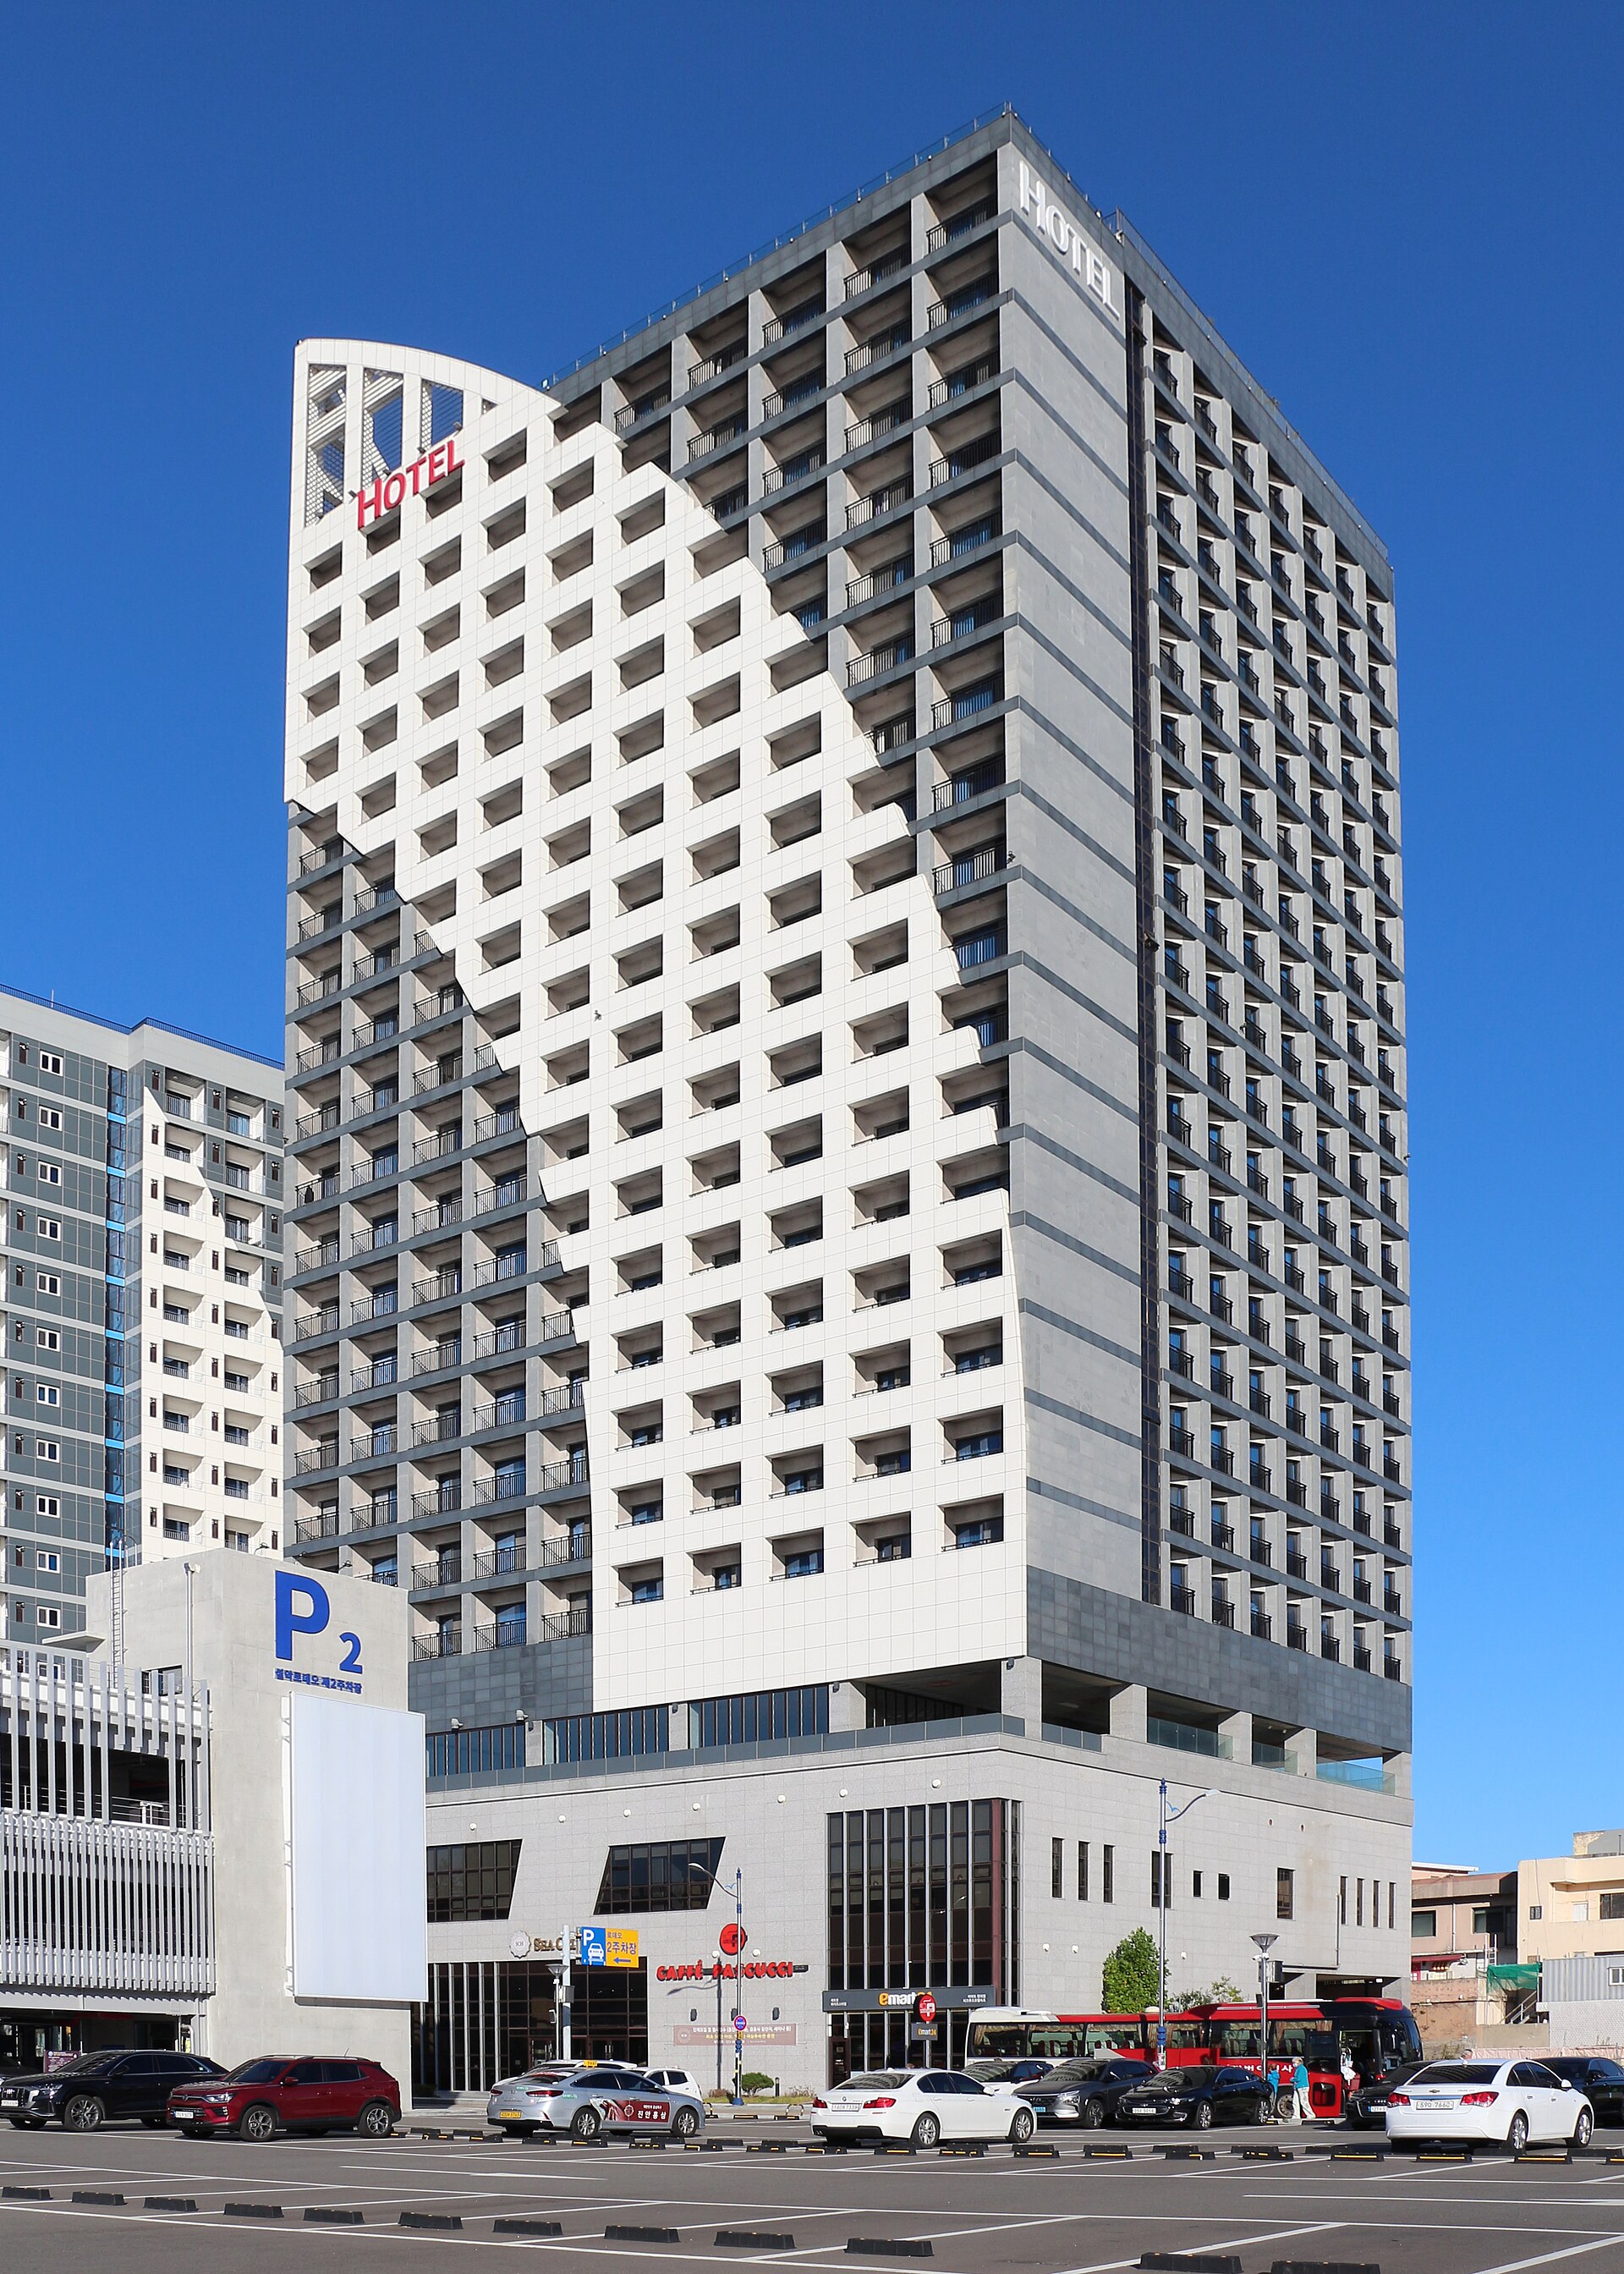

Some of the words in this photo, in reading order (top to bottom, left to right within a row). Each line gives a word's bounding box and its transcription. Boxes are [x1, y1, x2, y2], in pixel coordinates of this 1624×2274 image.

[1019, 160, 1120, 321] HOTEL
[358, 440, 465, 530] HOTEL
[275, 1569, 331, 1661] P
[339, 1632, 363, 1674] 2
[321, 1677, 362, 1695] 제2주차장
[583, 1929, 595, 1946] P
[606, 1942, 637, 1955] 2주차장
[712, 1961, 793, 1980] PASCUCCI
[879, 1991, 933, 2007] emart
[637, 2110, 667, 2120] 진안홍삼
